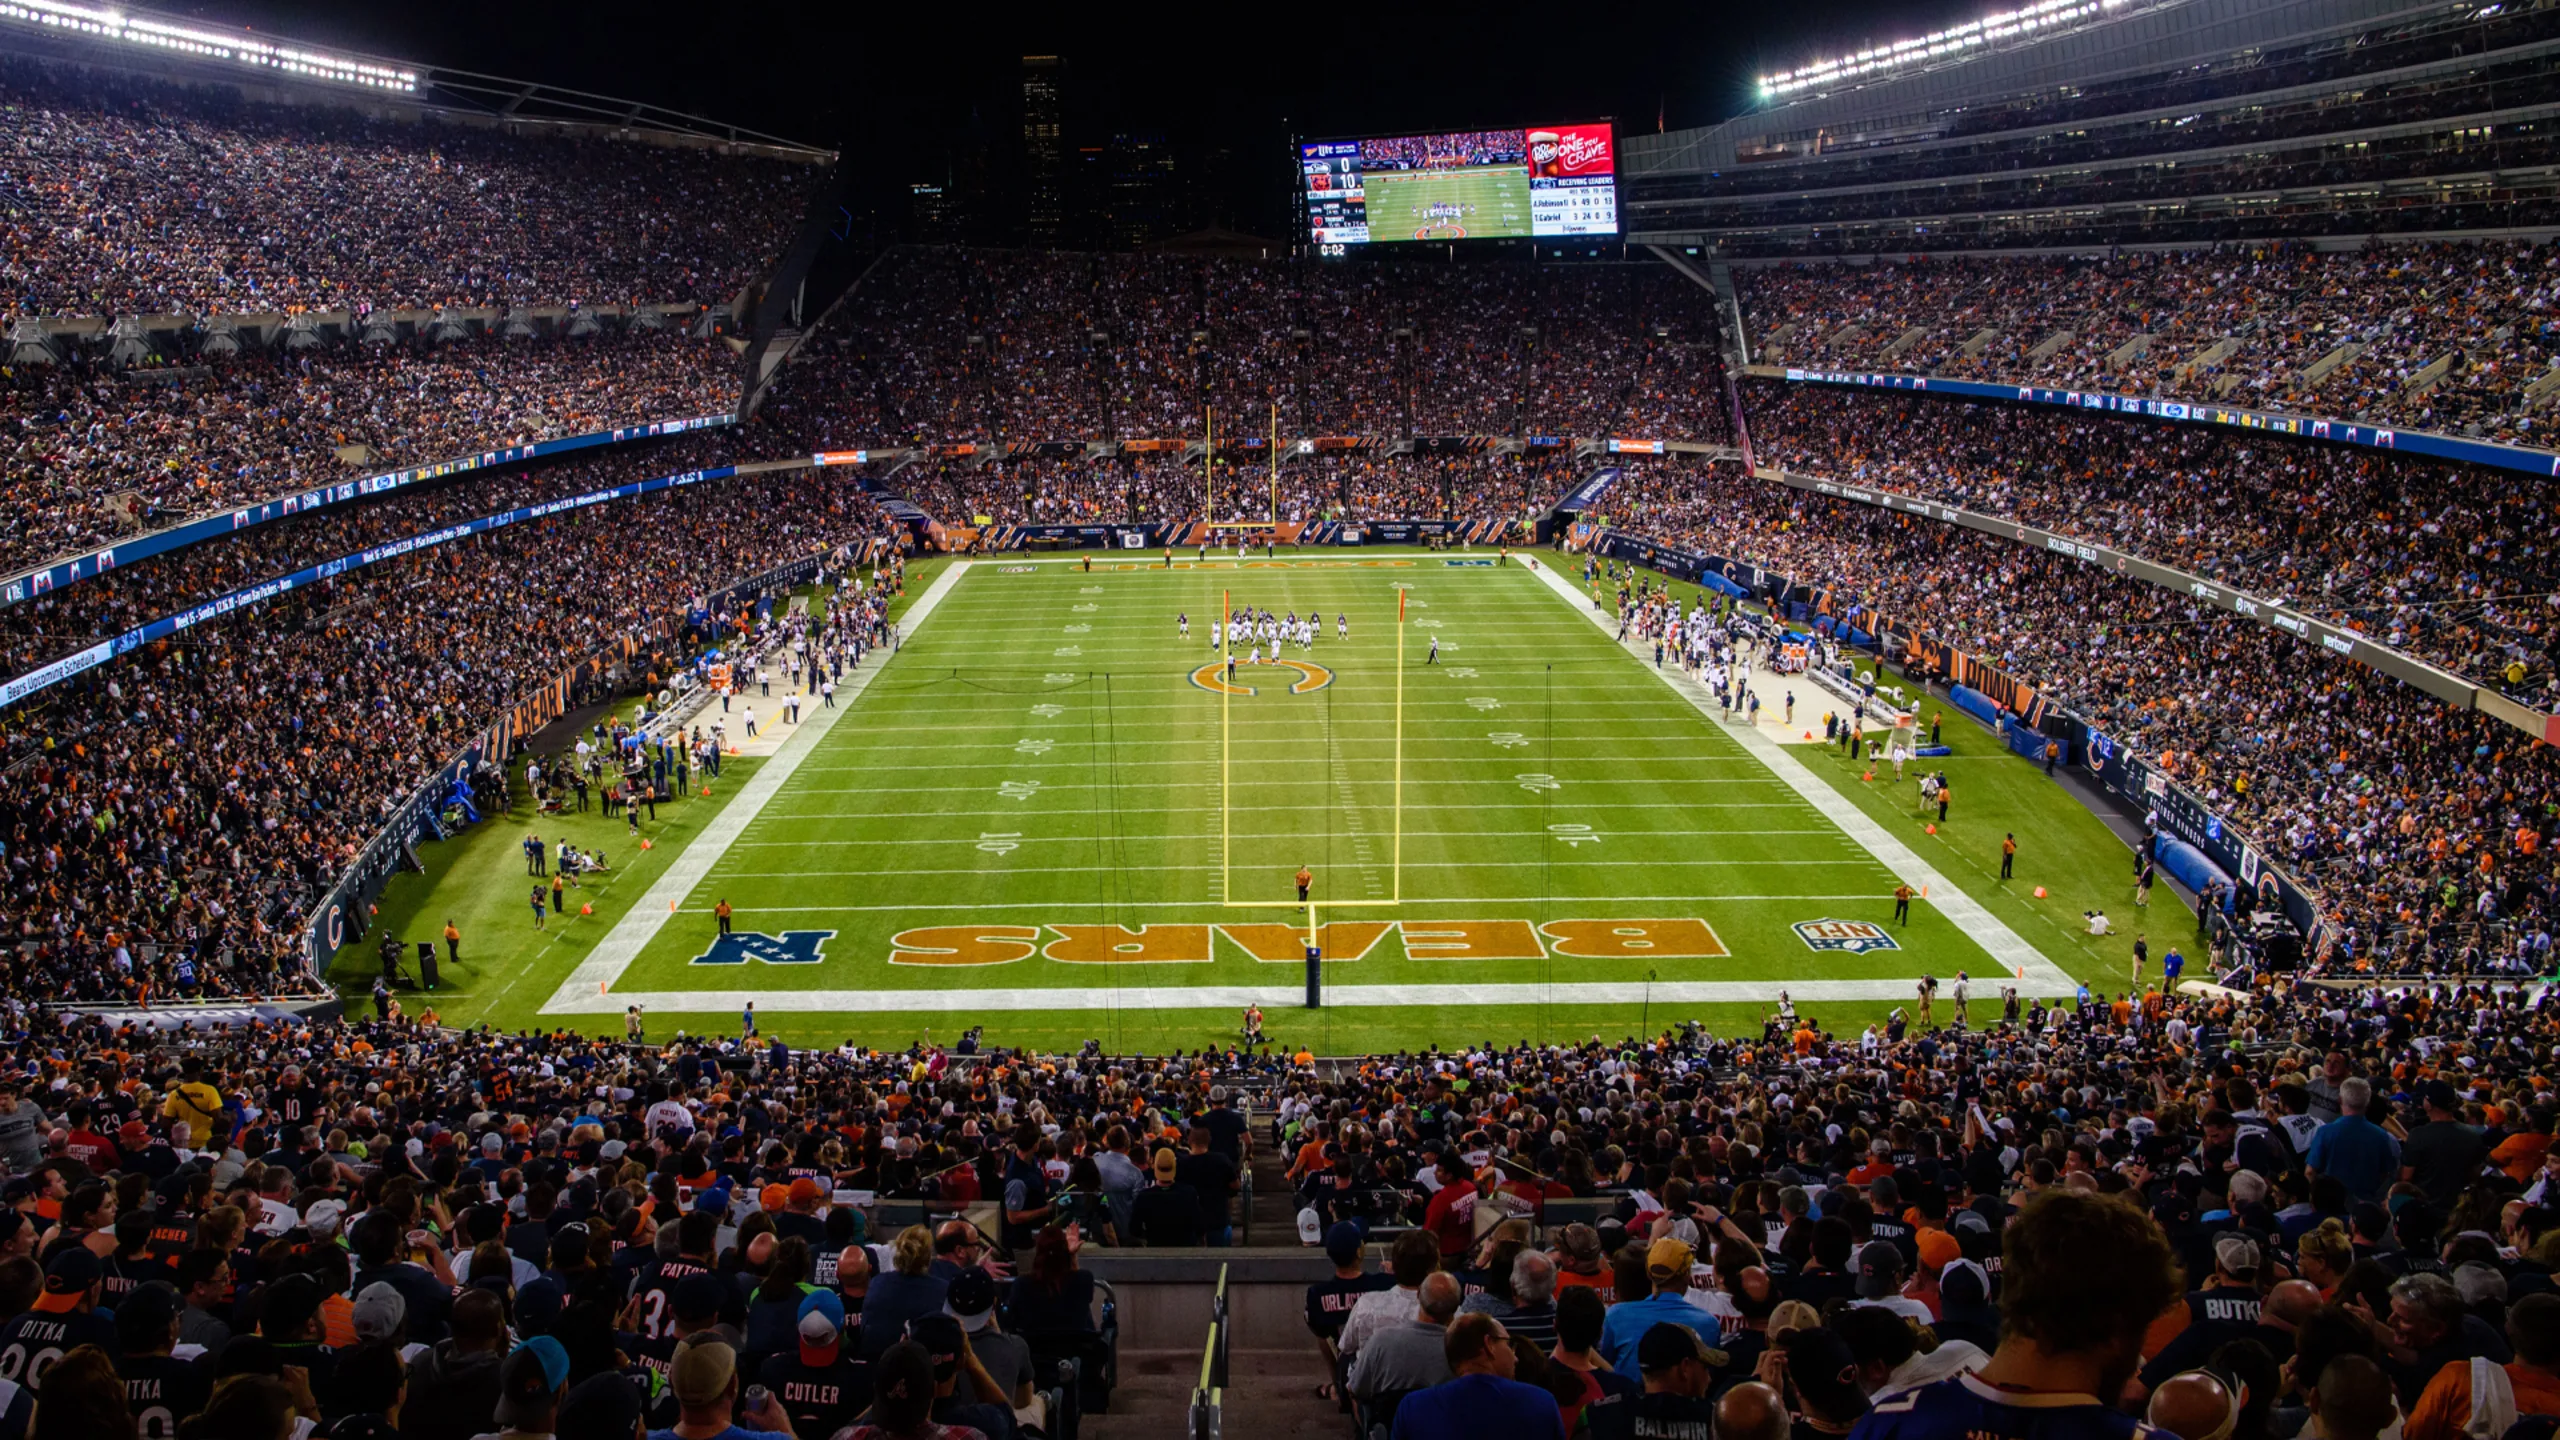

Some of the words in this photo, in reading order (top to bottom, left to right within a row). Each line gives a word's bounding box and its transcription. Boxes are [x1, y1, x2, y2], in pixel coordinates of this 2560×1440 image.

[1558, 137, 1584, 157] ONE
[1584, 137, 1598, 147] YOU
[1562, 132, 1576, 143] THE
[1341, 157, 1350, 172] 0
[1567, 142, 1606, 166] CRAVE
[1340, 173, 1355, 188] 10
[1321, 244, 1345, 256] 0:02
[2048, 538, 2075, 556] SOLDIER
[2077, 547, 2096, 561] FIELD
[2243, 601, 2258, 616] PNC
[7, 681, 27, 700] Bears
[27, 665, 64, 691] Upcoming
[64, 654, 96, 675] Schedule
[1966, 658, 2017, 709] DOWN
[328, 904, 343, 950] C
[1803, 921, 1883, 940] NFL
[888, 917, 1731, 967] BEARS
[285, 1098, 301, 1121] 10
[101, 1113, 121, 1135] 29
[18, 1320, 67, 1342] DITKA
[785, 1382, 839, 1405] CUTLER
[1635, 1416, 1707, 1440] BALDWIN
